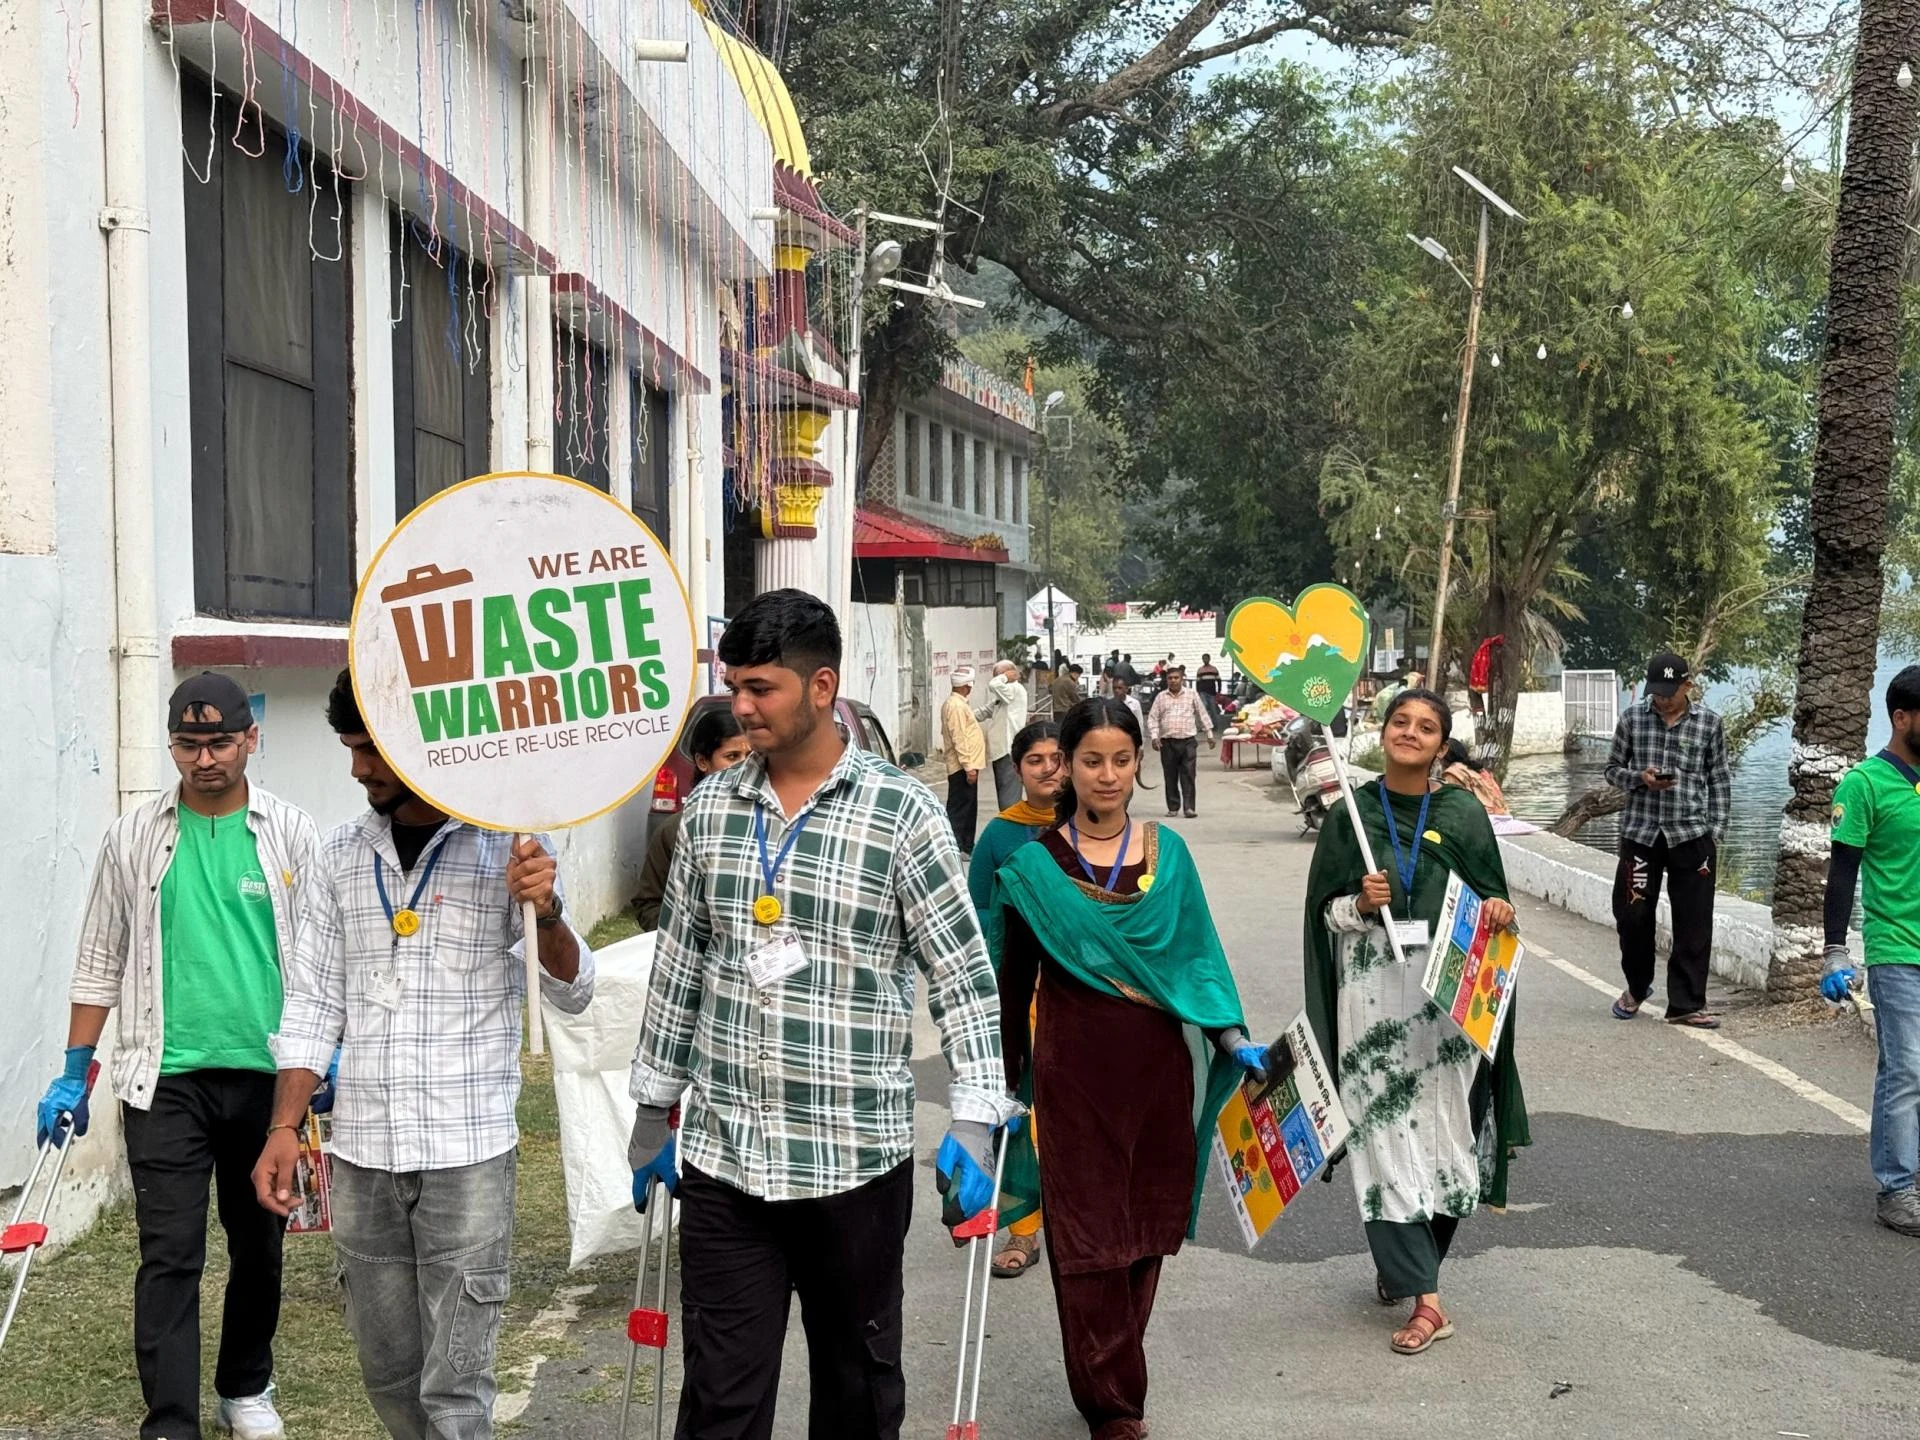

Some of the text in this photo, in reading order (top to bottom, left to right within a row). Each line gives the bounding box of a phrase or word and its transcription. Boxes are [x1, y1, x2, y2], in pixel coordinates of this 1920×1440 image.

[528, 545, 648, 580] WE ARE
[391, 577, 662, 688] WASTE
[412, 659, 670, 743] WARRIORS
[1302, 676, 1328, 698] REDUCE
[427, 715, 671, 768] REDUCE RE-USE RECYCLE
[1632, 855, 1648, 889] AIR
[1320, 1088, 1330, 1107] लिए
